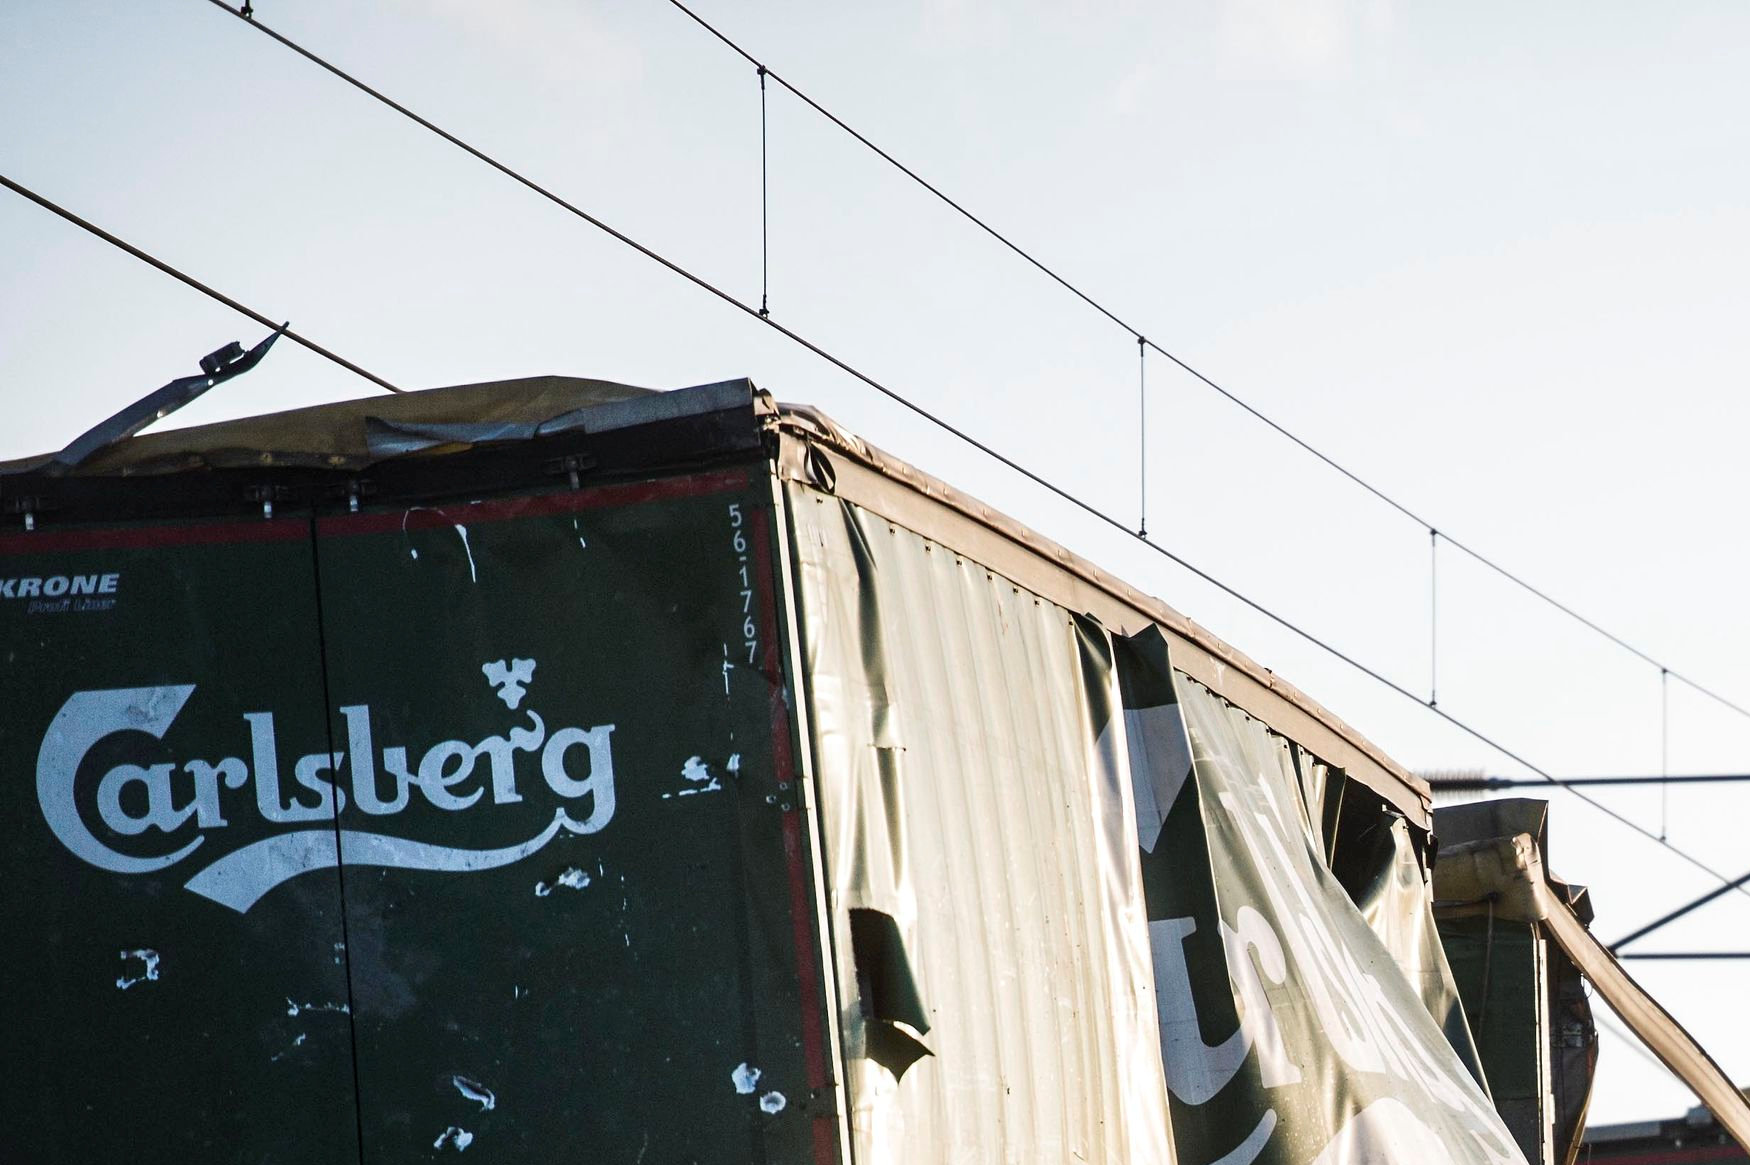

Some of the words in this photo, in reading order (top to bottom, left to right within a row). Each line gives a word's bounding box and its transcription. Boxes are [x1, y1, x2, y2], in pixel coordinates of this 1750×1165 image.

[0, 572, 120, 598] KRONE
[728, 503, 758, 664] 56-1767
[35, 684, 617, 874] Carlsberg
